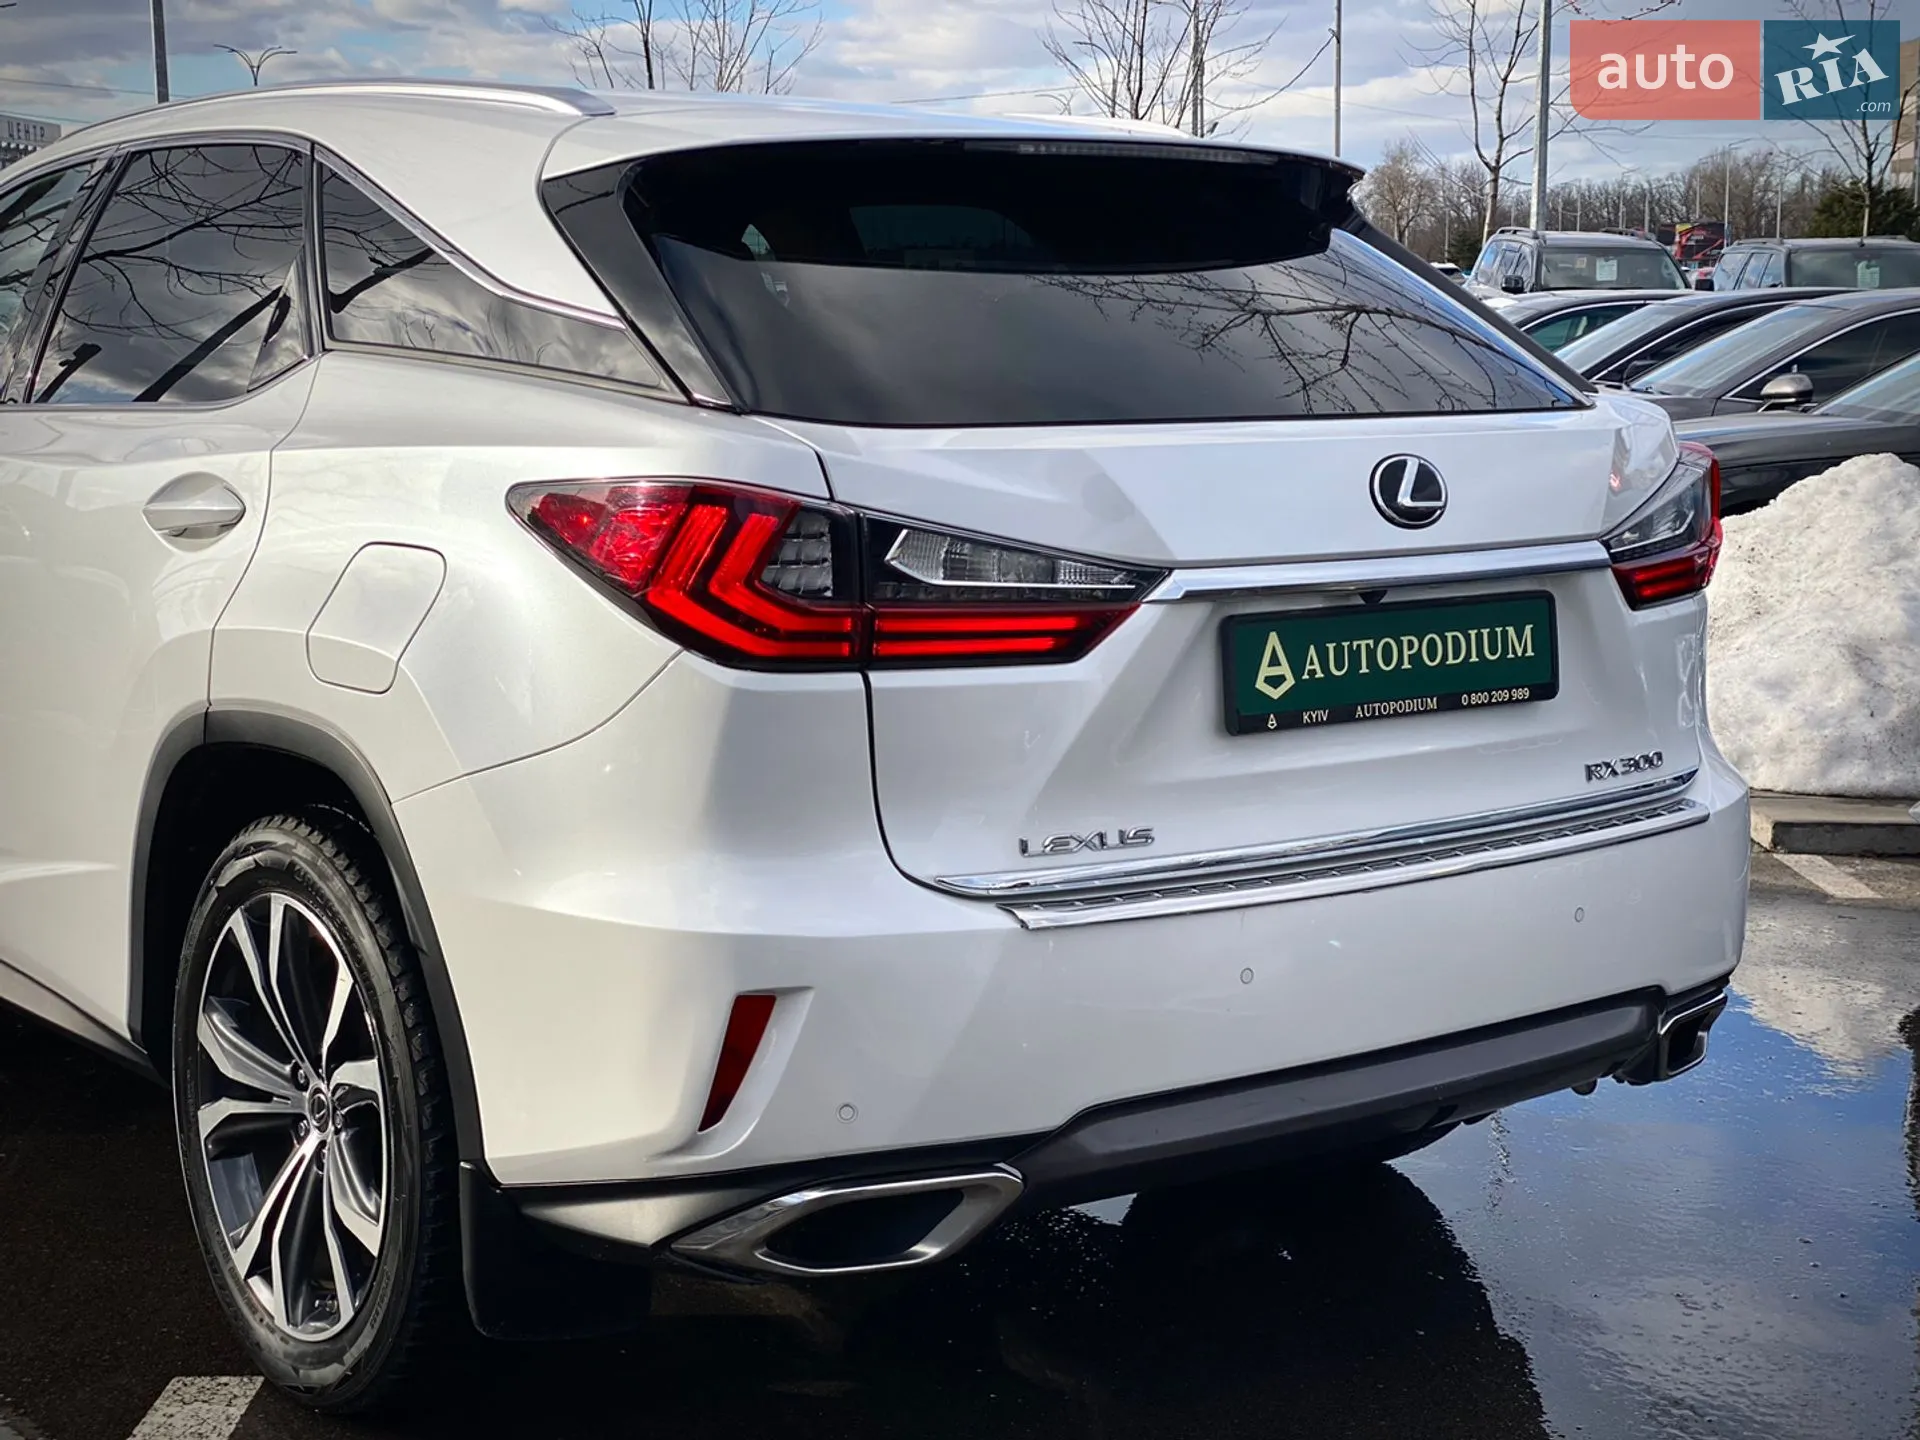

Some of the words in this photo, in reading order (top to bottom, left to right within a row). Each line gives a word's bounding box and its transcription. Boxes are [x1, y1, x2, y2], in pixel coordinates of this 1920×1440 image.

[7, 120, 46, 141] ЦЕНТР
[1301, 624, 1535, 680] AUTOPODIUM
[1302, 709, 1329, 724] KYIV
[1355, 696, 1438, 719] AUTOPODIUM
[1470, 692, 1489, 704] 800
[1491, 689, 1510, 703] 209
[1511, 687, 1530, 701] 989
[1019, 827, 1155, 857] LEXUS
